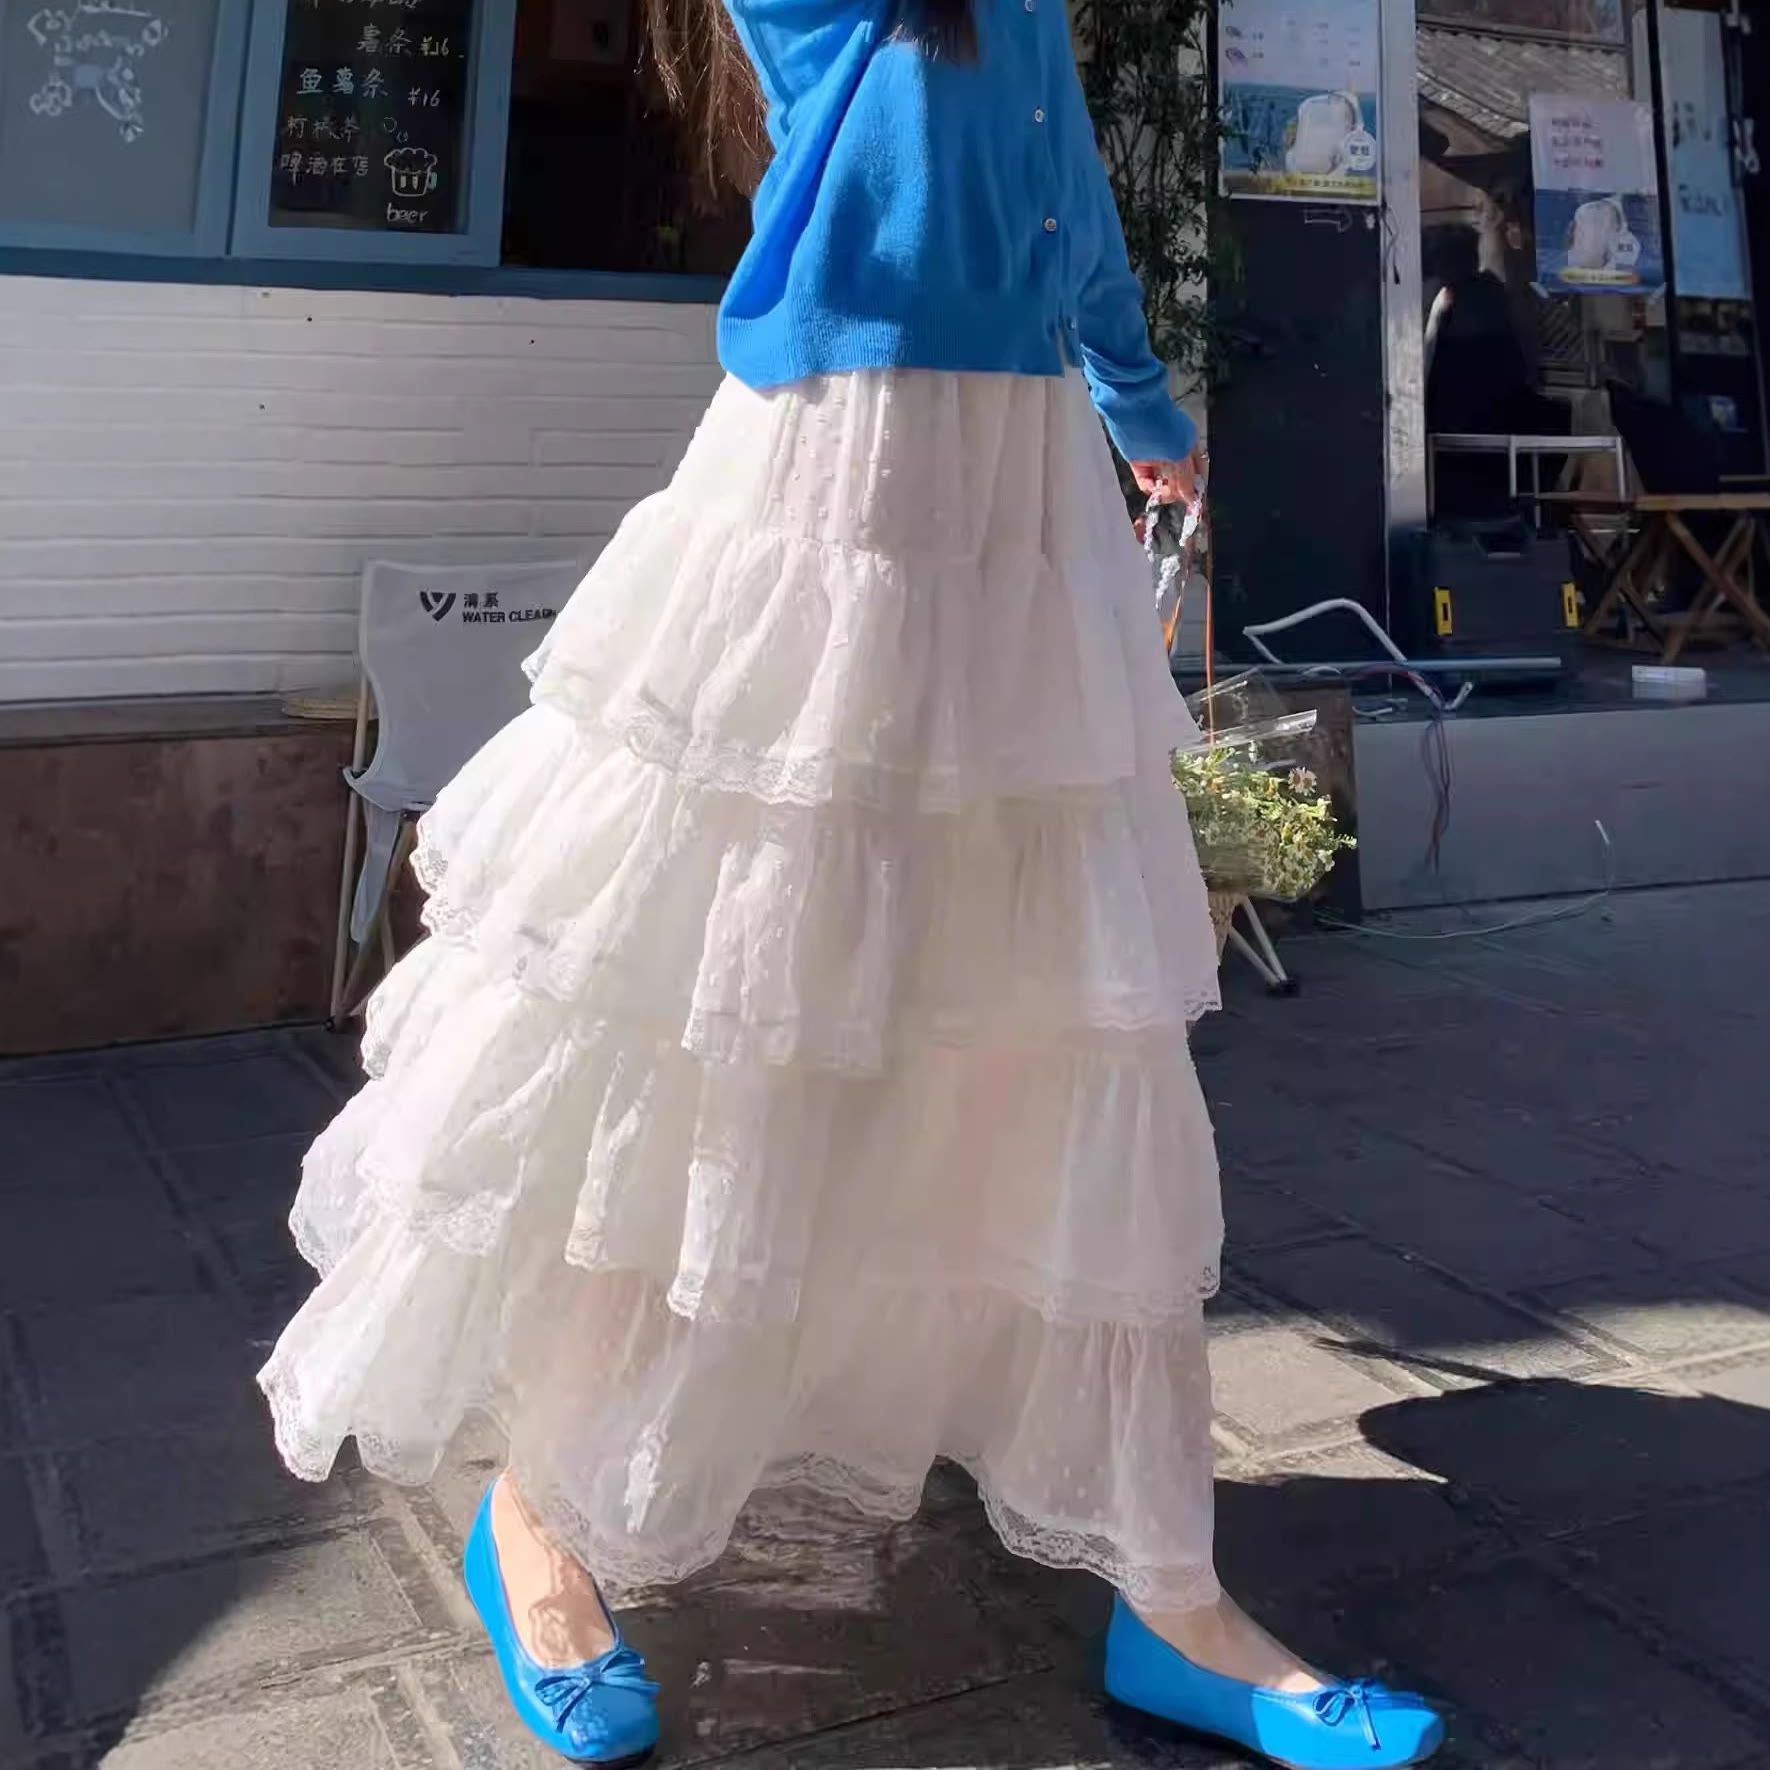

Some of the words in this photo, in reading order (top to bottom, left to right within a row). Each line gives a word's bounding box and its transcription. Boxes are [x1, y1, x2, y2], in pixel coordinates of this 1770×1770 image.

[408, 87, 441, 107] ¥16
[386, 202, 430, 224] beer
[463, 611, 506, 623] WATER
